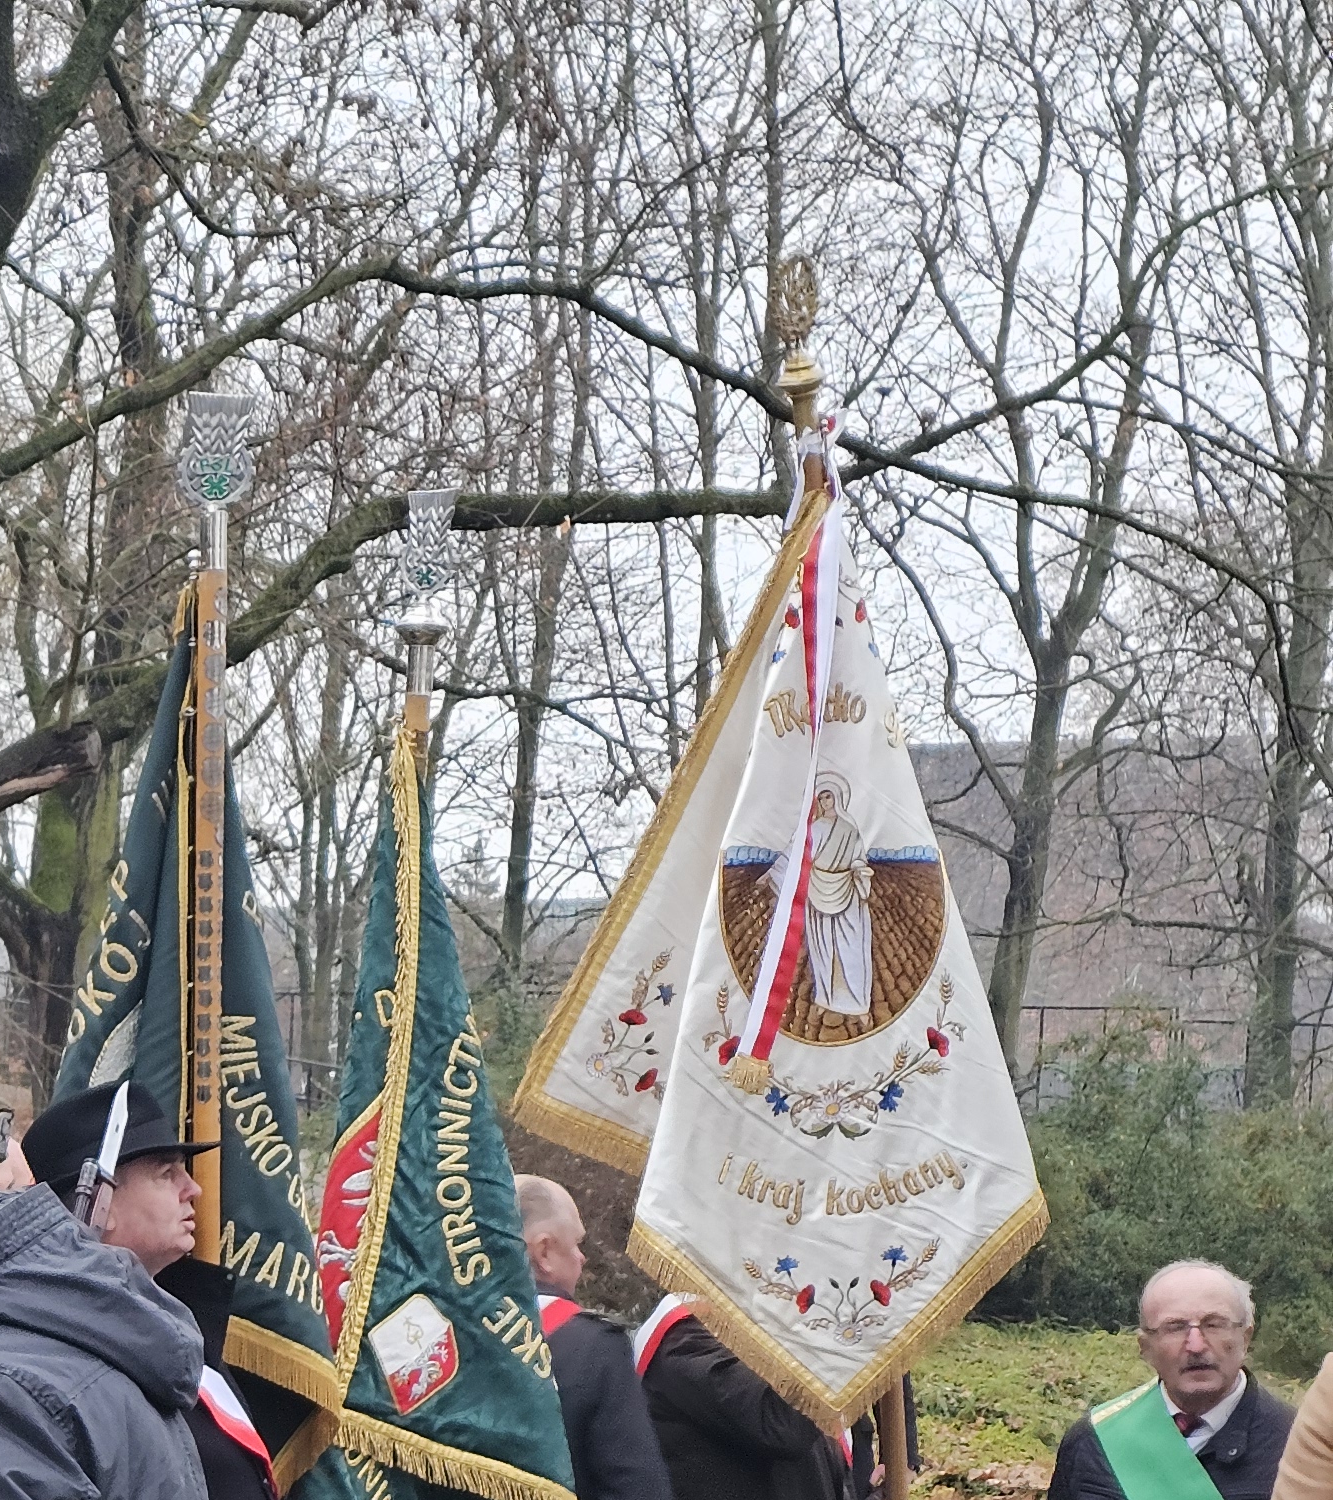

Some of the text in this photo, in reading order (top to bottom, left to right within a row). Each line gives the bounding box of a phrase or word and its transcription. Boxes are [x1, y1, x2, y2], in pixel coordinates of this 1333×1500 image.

[220, 1014, 311, 1233] MIEJSKO-G
[718, 1151, 734, 1185] i
[738, 1159, 806, 1226] kraj
